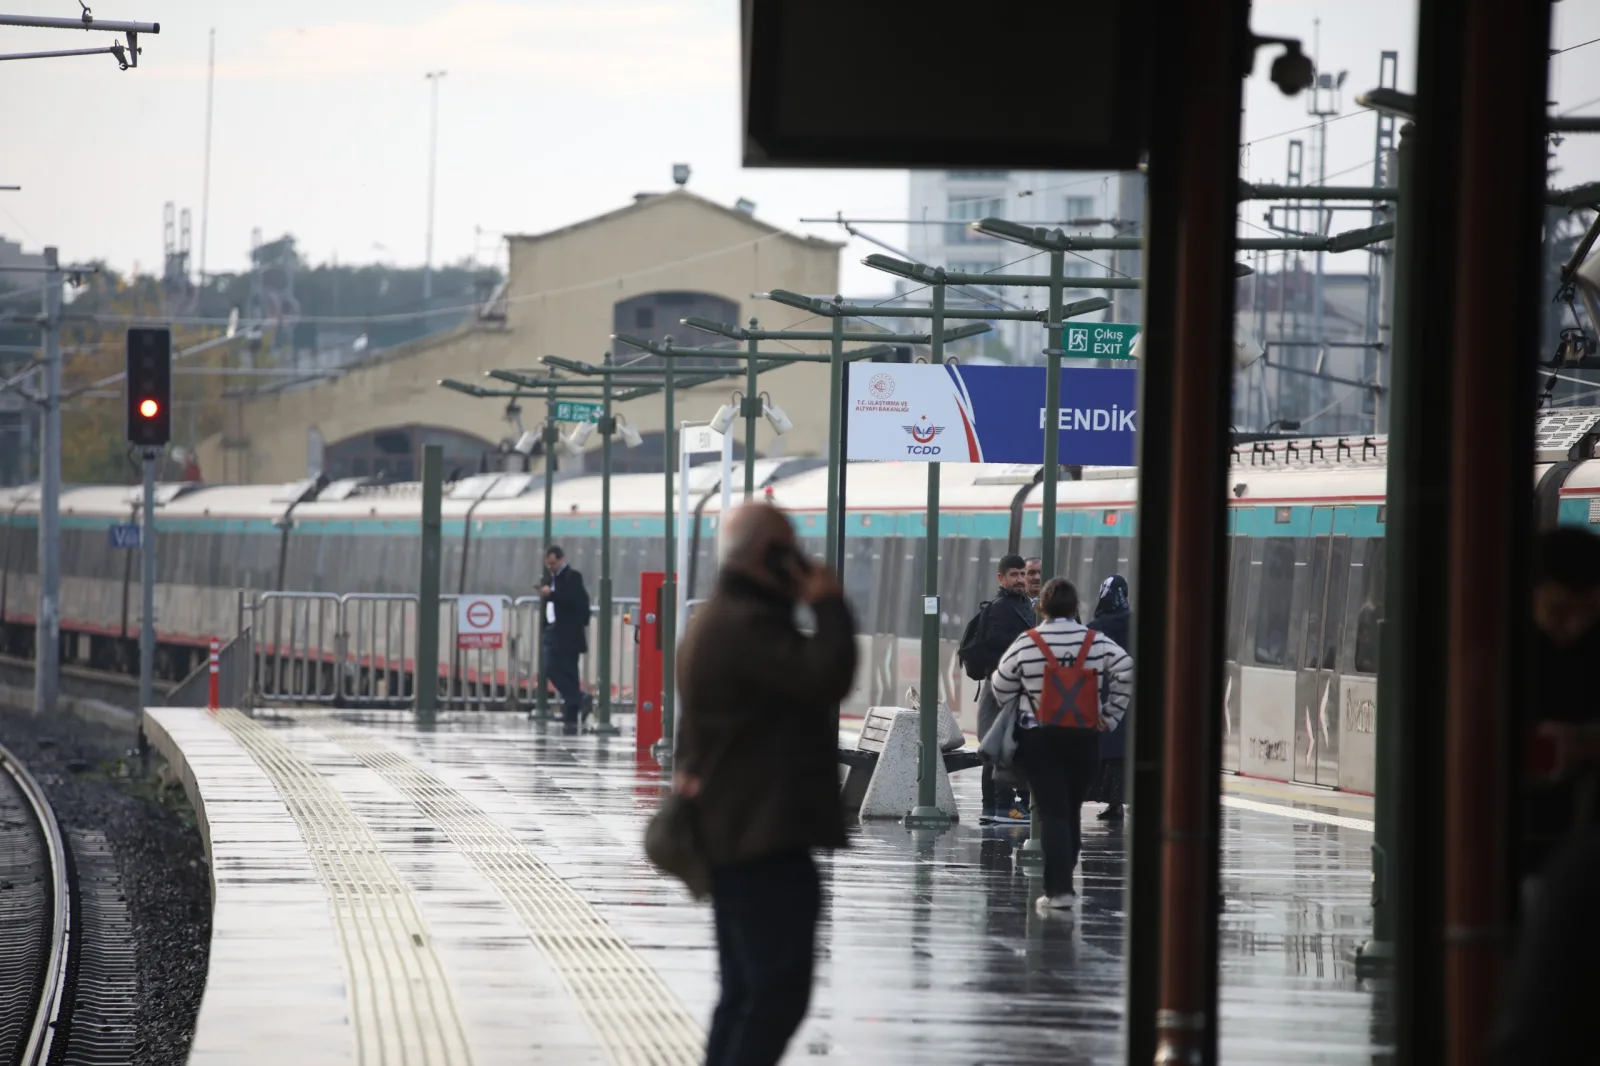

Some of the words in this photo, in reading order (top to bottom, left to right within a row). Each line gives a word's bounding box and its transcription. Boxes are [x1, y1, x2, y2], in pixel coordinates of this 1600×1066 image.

[1094, 328, 1123, 342] Çıkış
[1093, 343, 1123, 354] EXIT
[907, 446, 941, 455] TCDD
